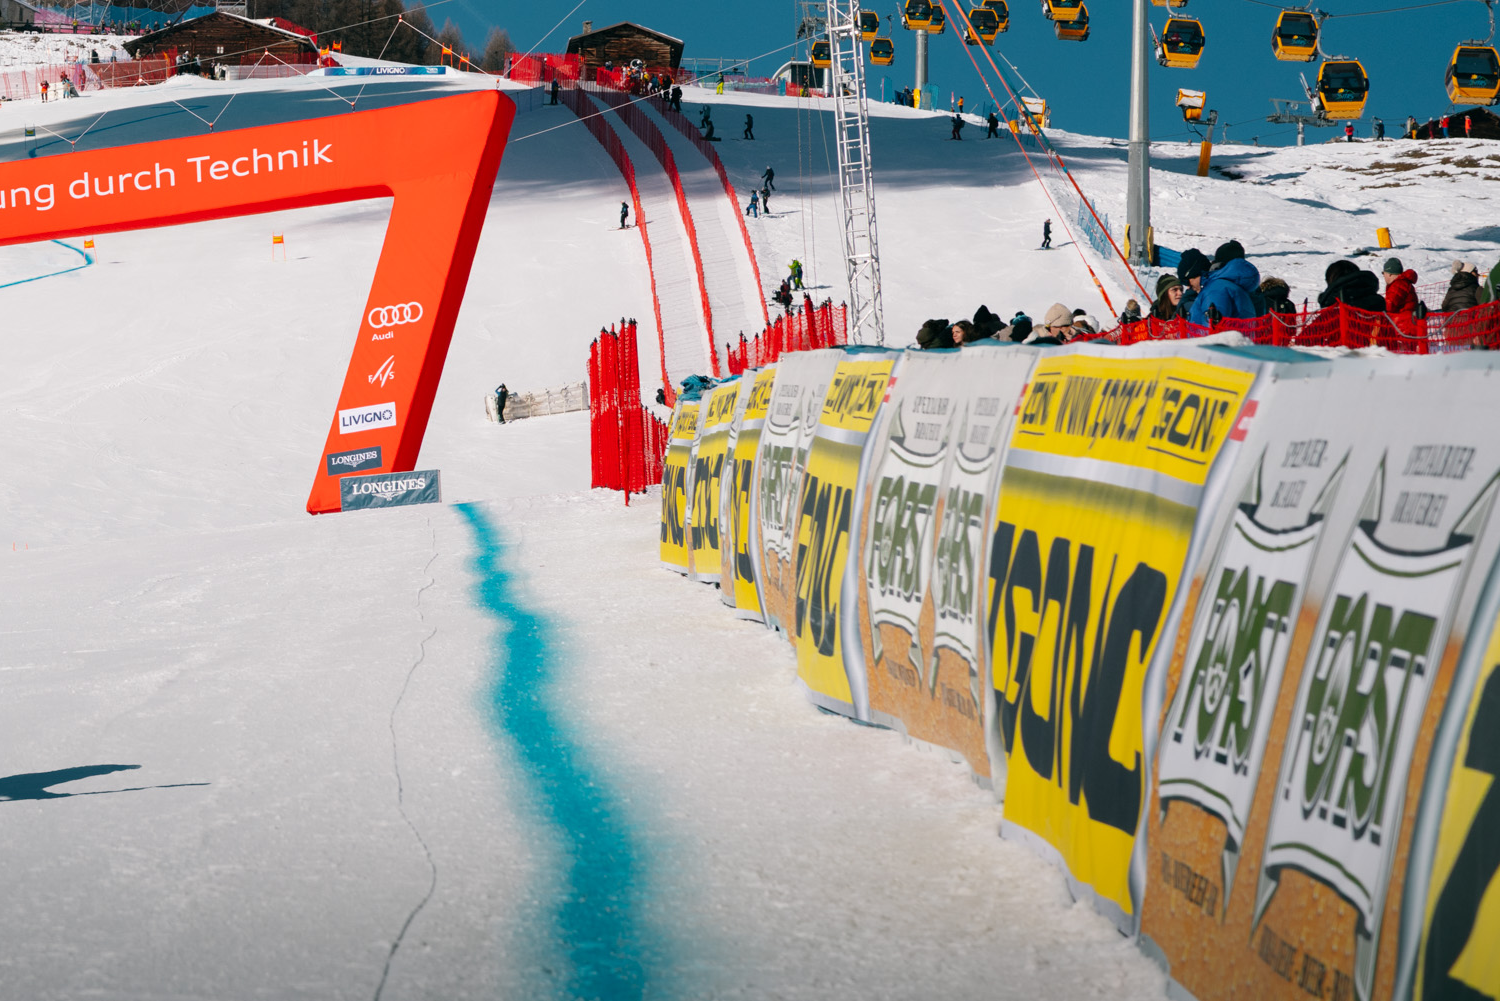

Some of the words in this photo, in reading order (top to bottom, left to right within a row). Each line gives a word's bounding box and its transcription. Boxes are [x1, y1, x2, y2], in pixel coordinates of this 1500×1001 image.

[376, 67, 406, 75] LIVIGNO
[68, 162, 176, 200] durch
[186, 138, 334, 183] Technik
[371, 331, 394, 342] Audi
[342, 409, 393, 428] LIVIGNO
[331, 451, 378, 466] LONGINES
[352, 477, 426, 496] LONGINES
[1283, 590, 1438, 847] FORST
